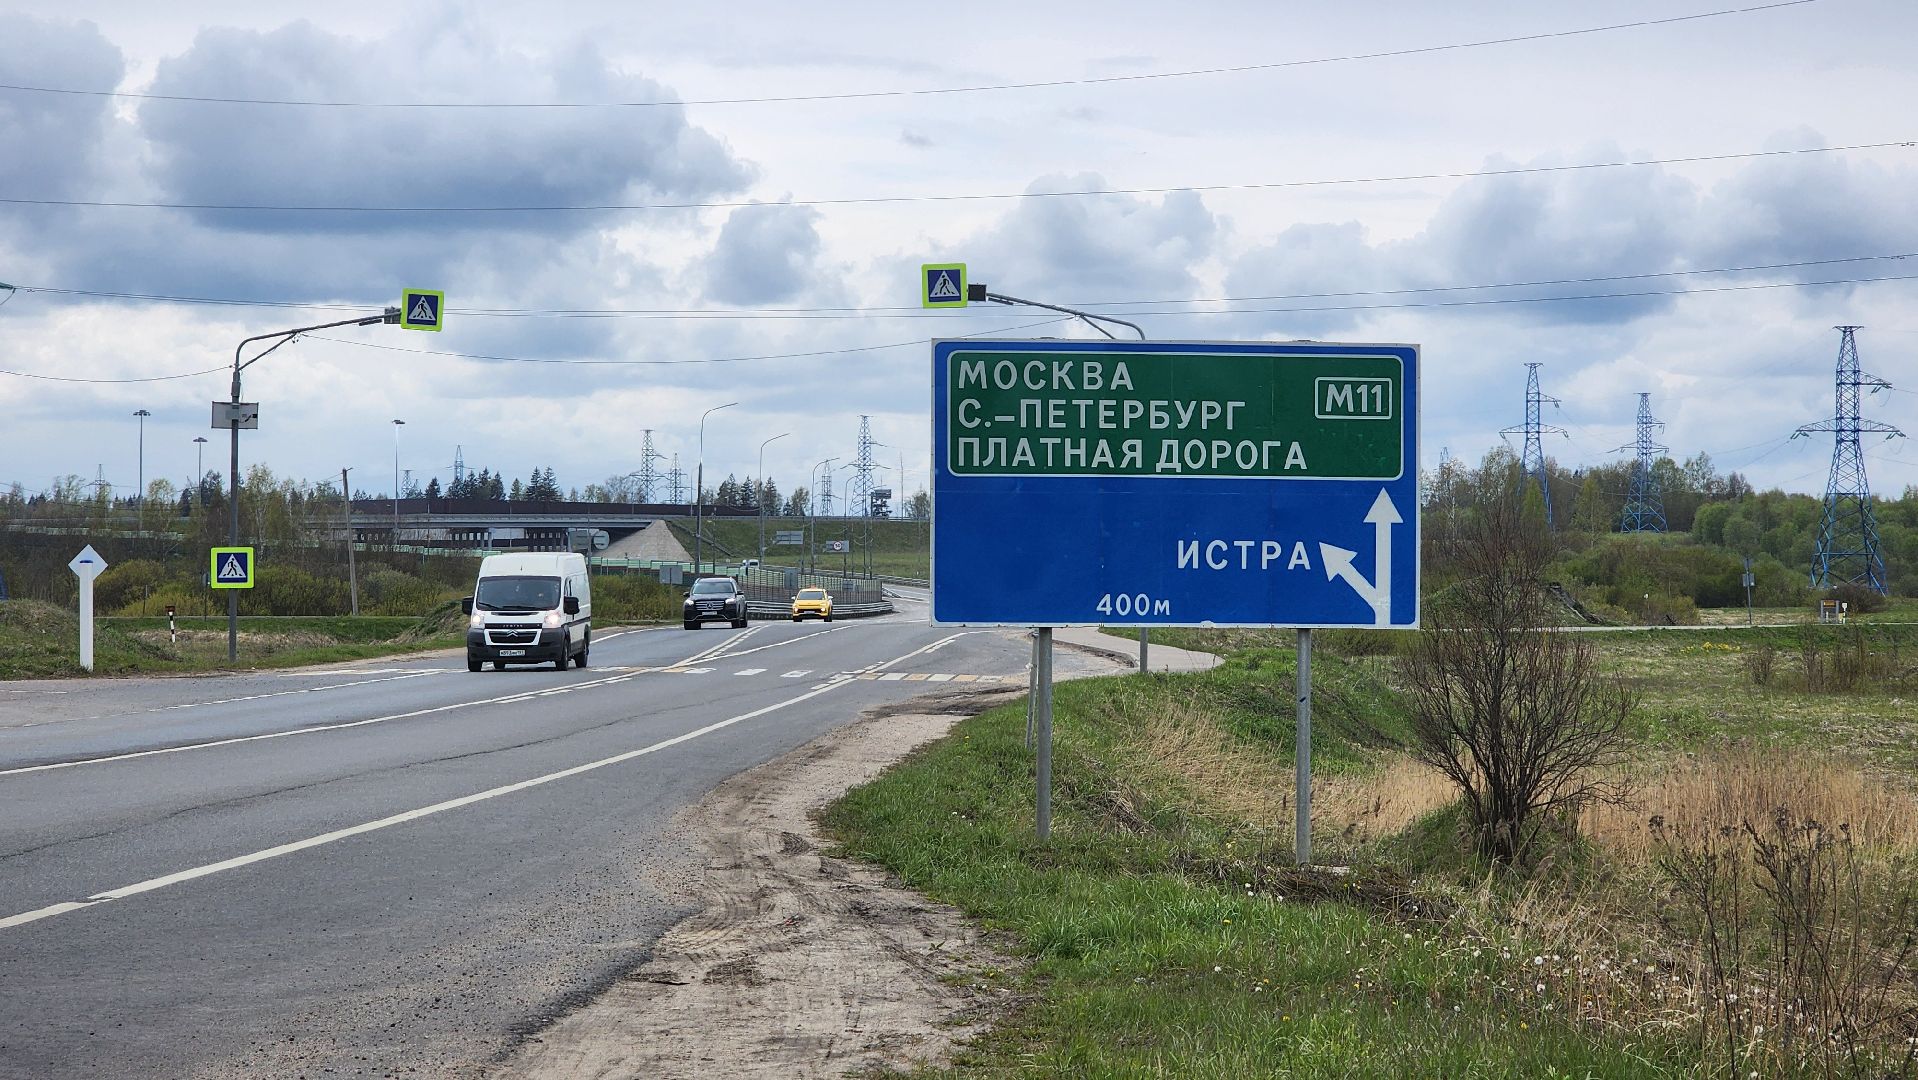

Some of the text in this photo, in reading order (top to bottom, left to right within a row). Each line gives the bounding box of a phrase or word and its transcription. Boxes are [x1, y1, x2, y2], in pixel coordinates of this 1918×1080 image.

[958, 360, 1134, 391] МОСКВА
[1325, 383, 1382, 413] М11
[958, 437, 1308, 473] ПЛАТНАЯ ДОРОГА
[1177, 539, 1311, 570] ИСТРА
